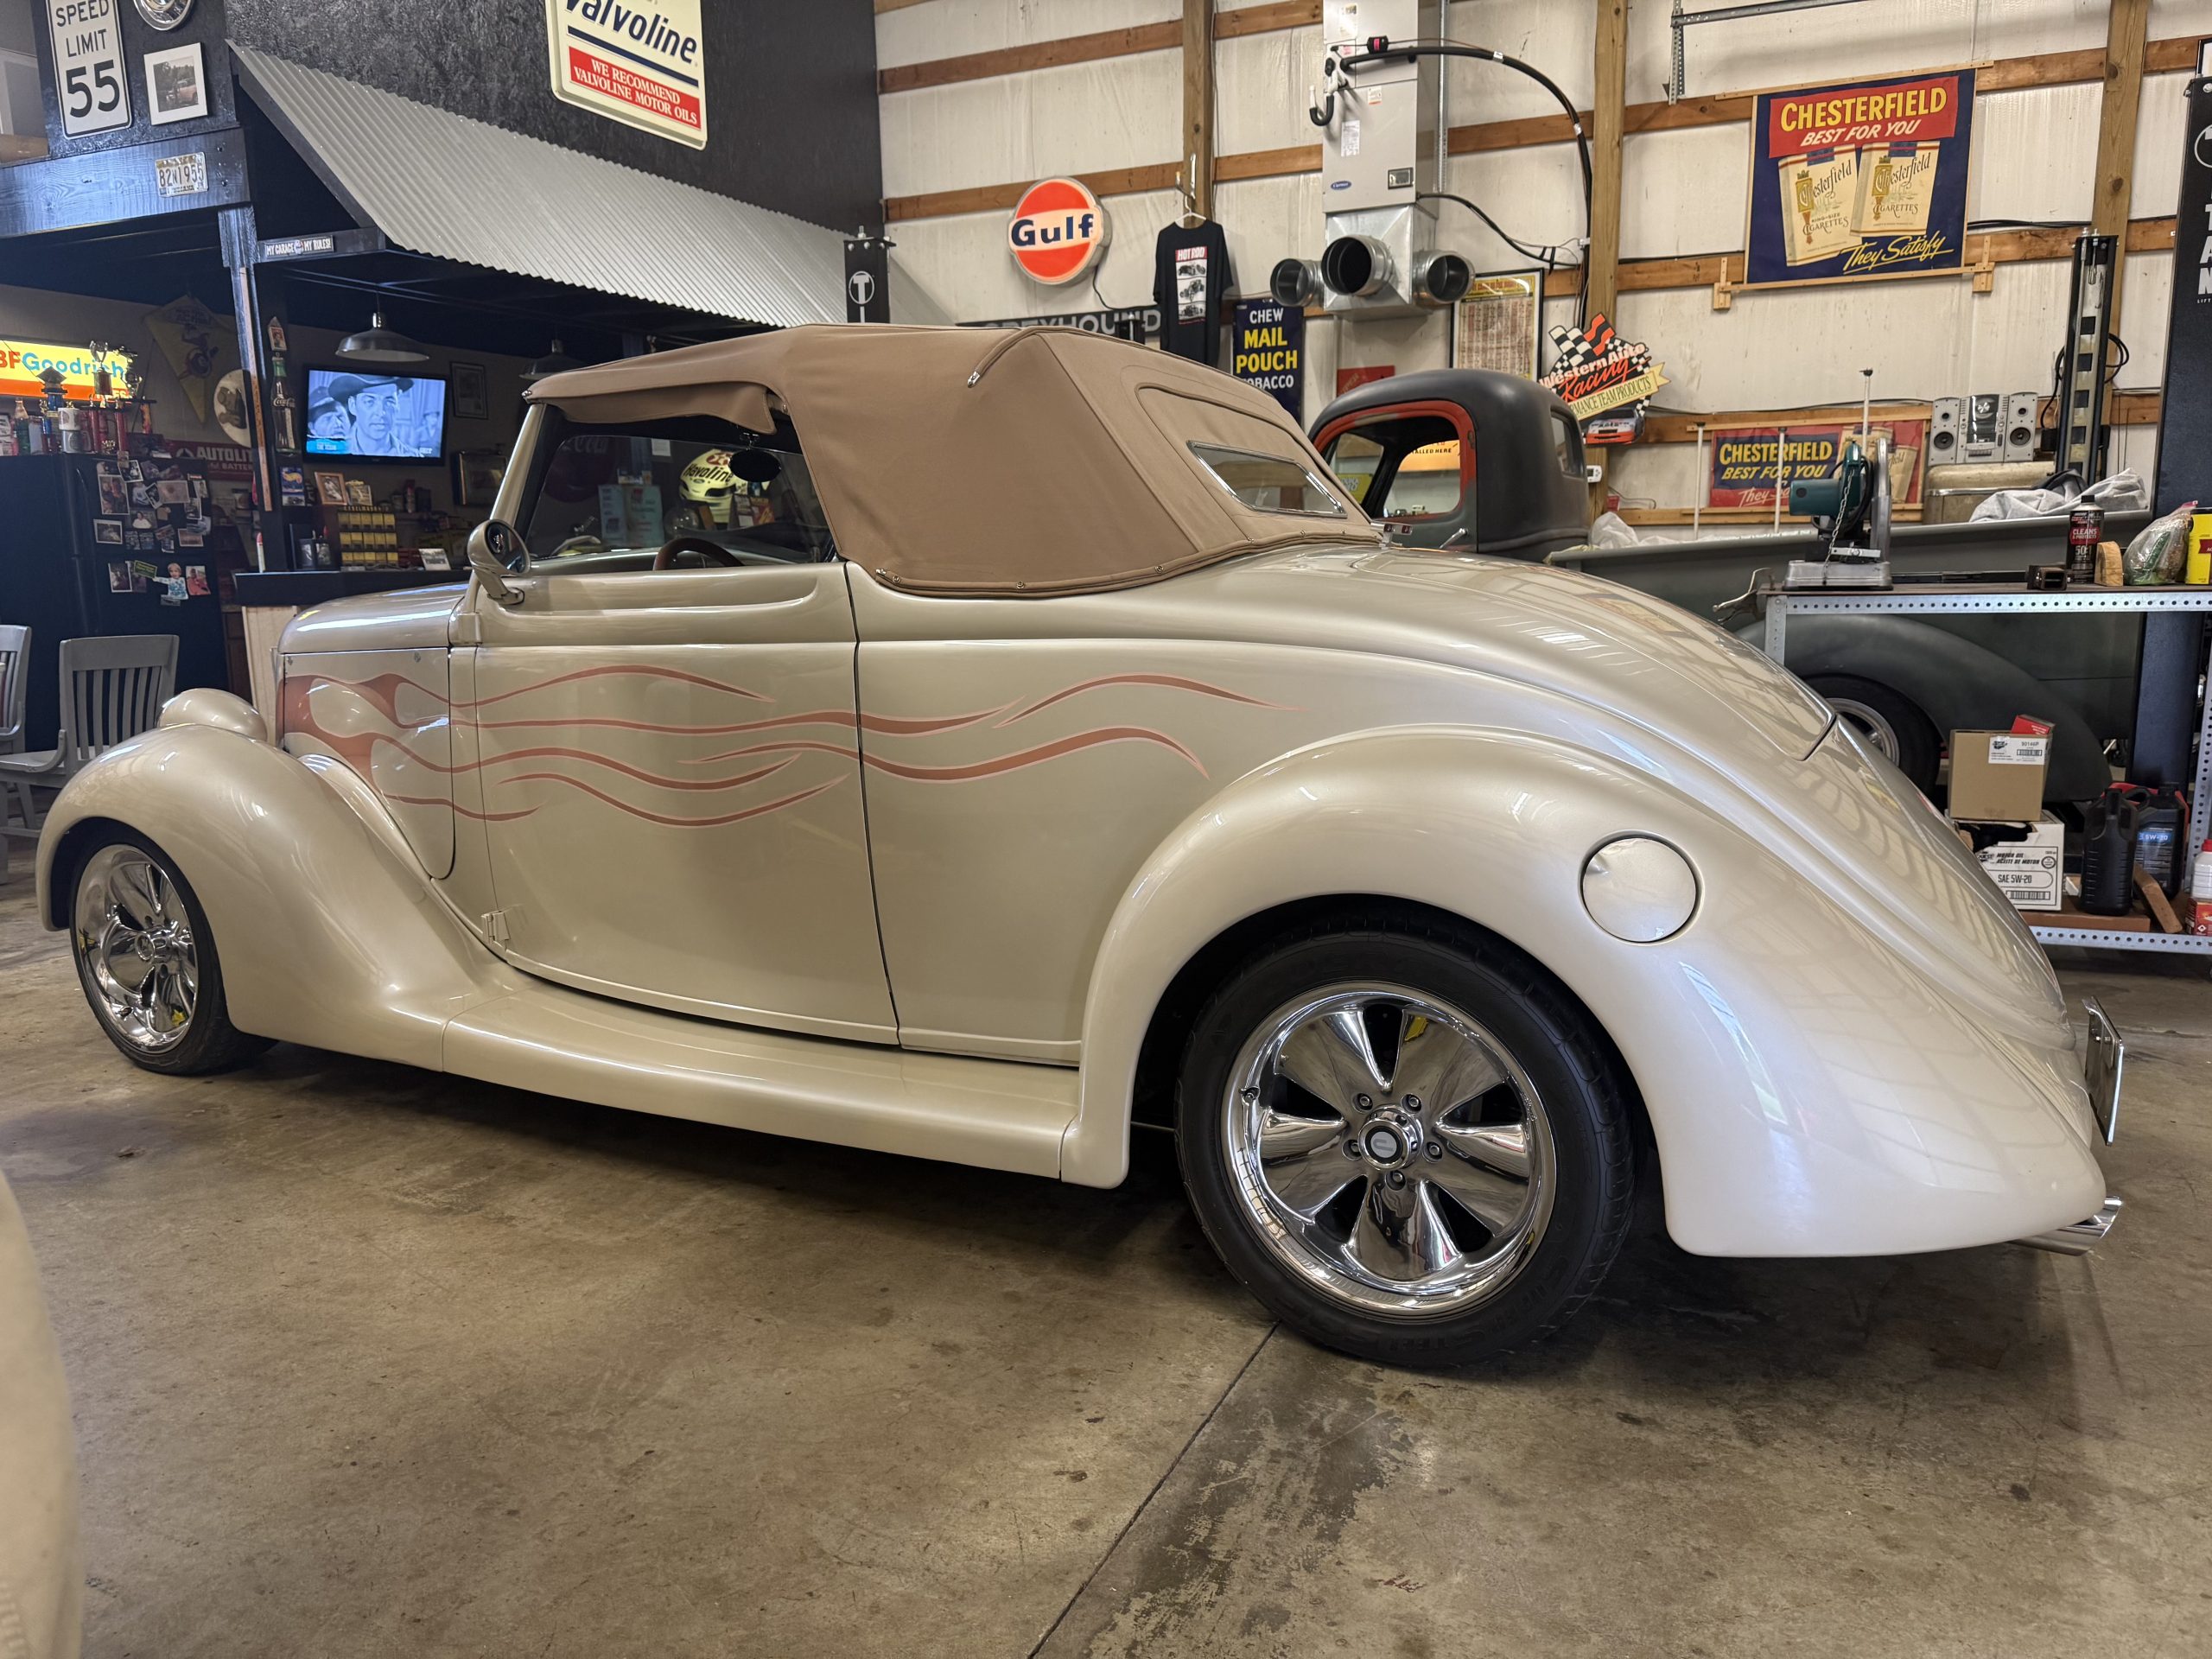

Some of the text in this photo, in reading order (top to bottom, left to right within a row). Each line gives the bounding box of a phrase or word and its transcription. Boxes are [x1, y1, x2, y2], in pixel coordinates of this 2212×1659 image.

[56, 0, 109, 27] SPEED
[66, 29, 107, 58] LIMIT
[66, 59, 120, 118] 55
[591, 58, 681, 105] WE RECOMMEND
[573, 66, 698, 125] VALVOLINE MOTOR OILS
[1780, 86, 1948, 132] CHESTERFIELD
[1800, 119, 1922, 147] BEST FOR YOU
[1872, 203, 1919, 219] CIGARETTES
[1011, 213, 1094, 246] Gulf
[1802, 216, 1850, 235] CIGARETTES
[266, 245, 275, 256] MY
[275, 242, 295, 255] GARAGE
[303, 240, 312, 251] MY
[1178, 246, 1205, 261] HOT ROD
[1840, 230, 1946, 270] They Satisfy
[1249, 308, 1284, 324] CHEW
[1244, 327, 1288, 350] MAIL
[1236, 349, 1298, 374] POUCH
[1244, 375, 1294, 390] OBACCO
[1558, 357, 1630, 403] Racing
[1598, 389, 1619, 409] TEAM
[1618, 376, 1652, 402] PRODUCTS
[196, 446, 254, 462] AUTOLIT
[1719, 441, 1833, 465] CHESTERFIELD
[683, 463, 734, 483] Havoline
[1721, 464, 1828, 480] BEST FOR YOU
[1738, 486, 1770, 508] They
[1998, 874, 2032, 884] SAE 5W-20
